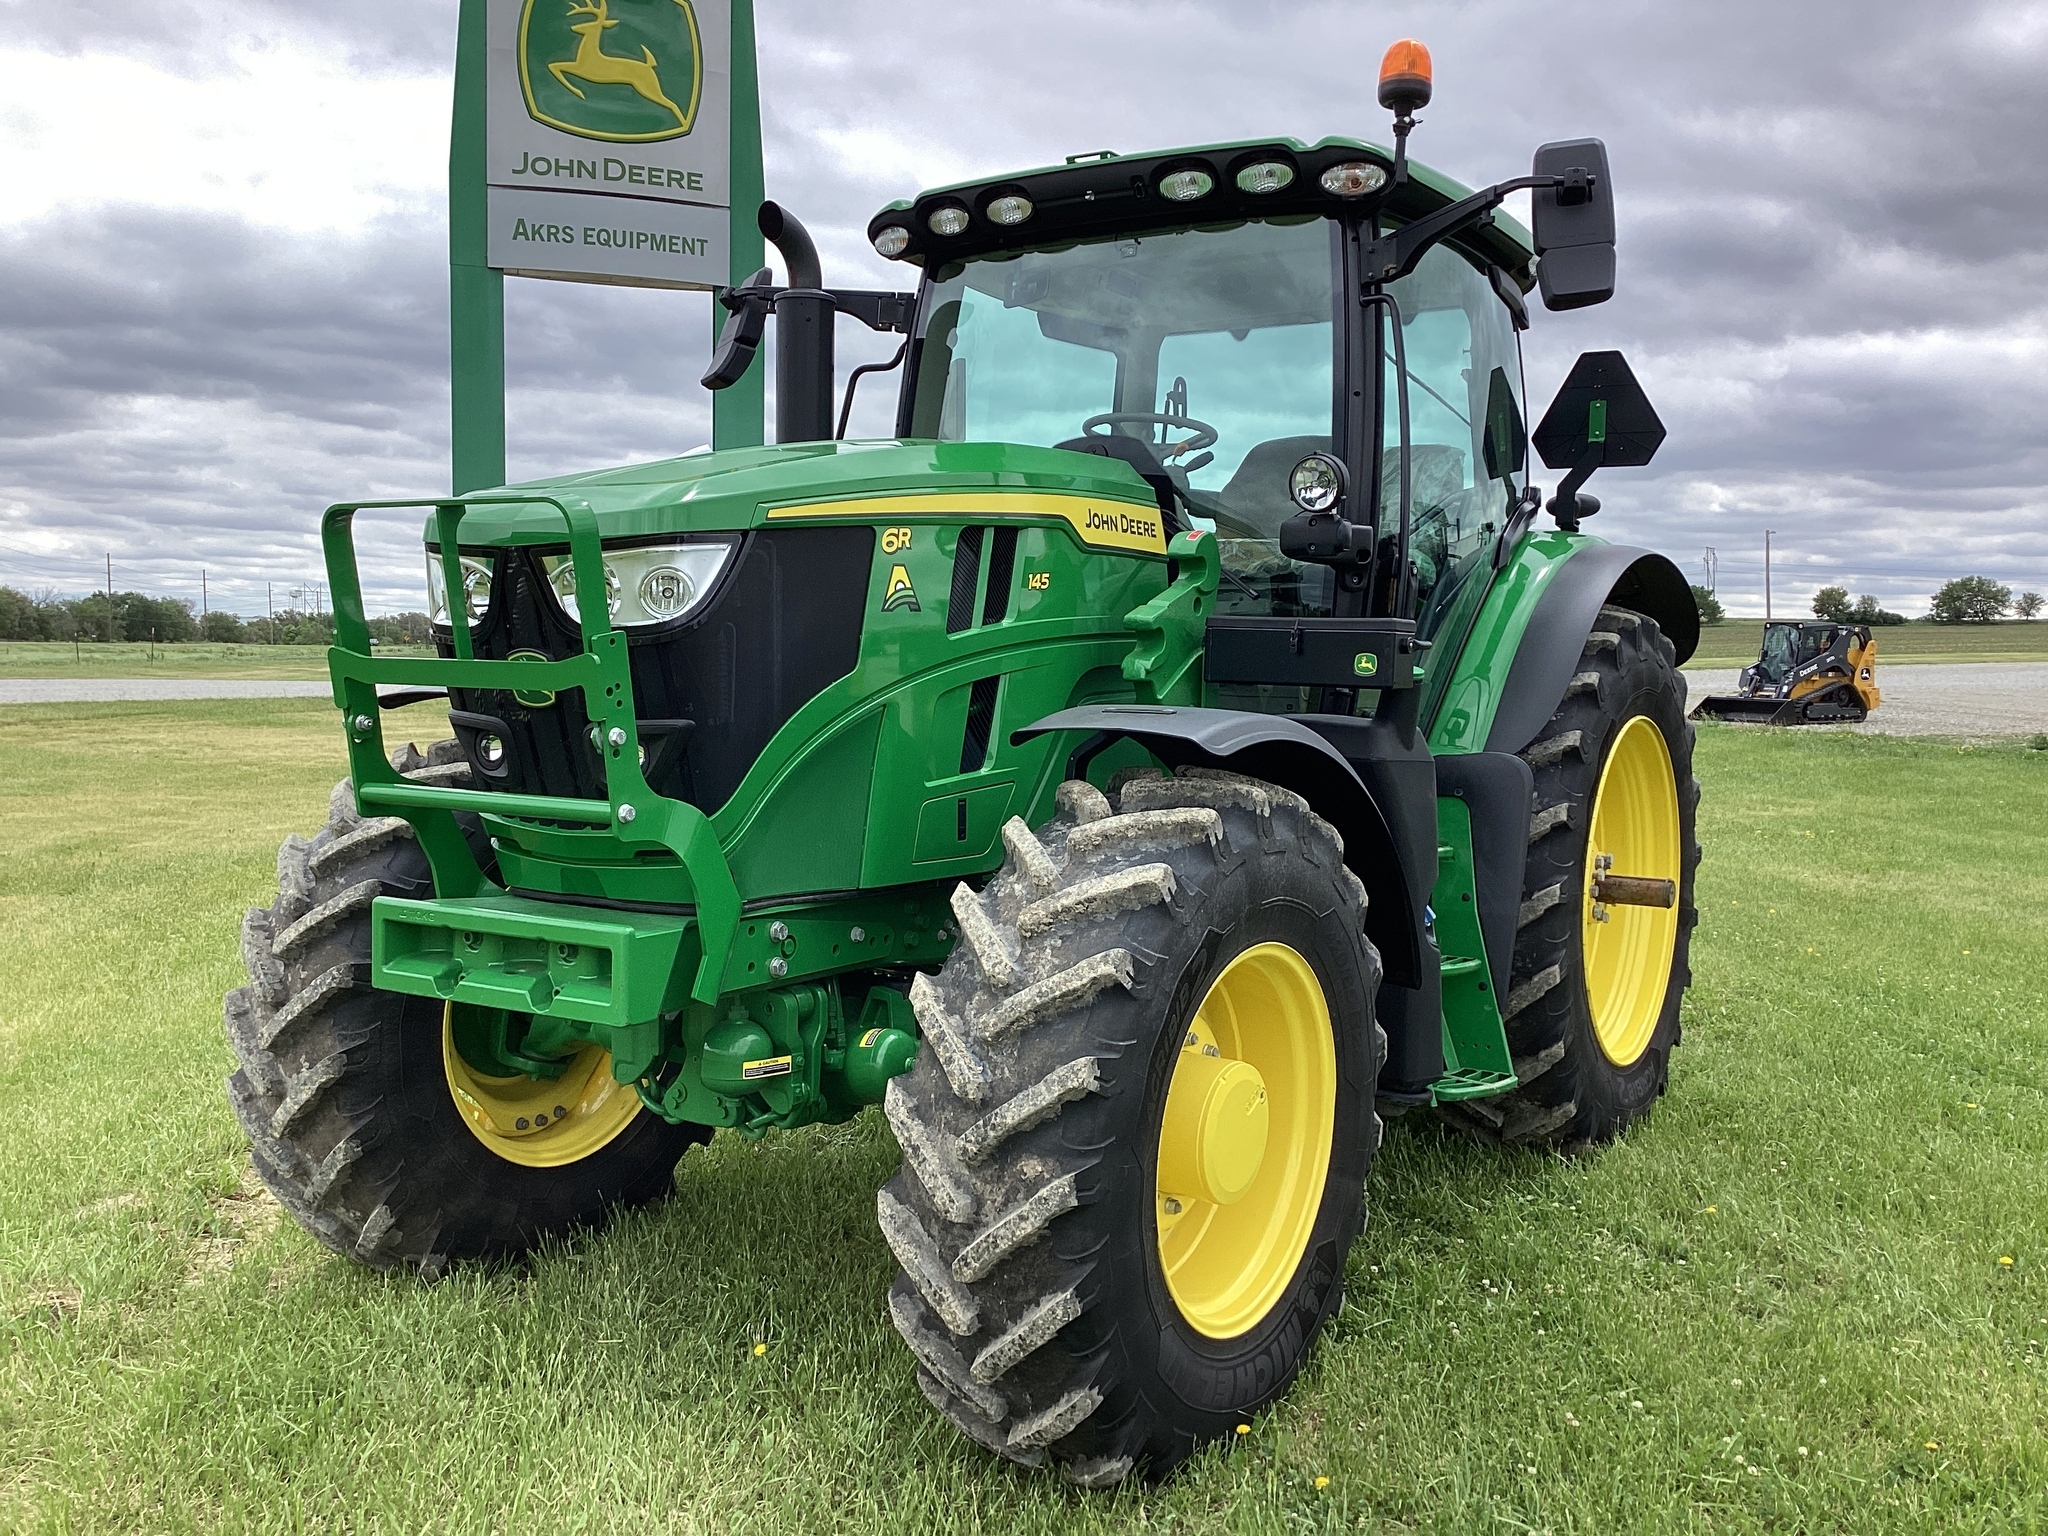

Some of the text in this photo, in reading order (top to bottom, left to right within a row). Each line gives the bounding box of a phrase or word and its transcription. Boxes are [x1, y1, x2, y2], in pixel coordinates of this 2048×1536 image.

[511, 152, 704, 192] JOHN DEERE
[512, 218, 709, 257] AKRS EQUIPMENT
[1085, 508, 1119, 532] JOHN
[1121, 513, 1158, 539] DEERE
[881, 527, 912, 555] 6R
[1027, 573, 1050, 590] 145
